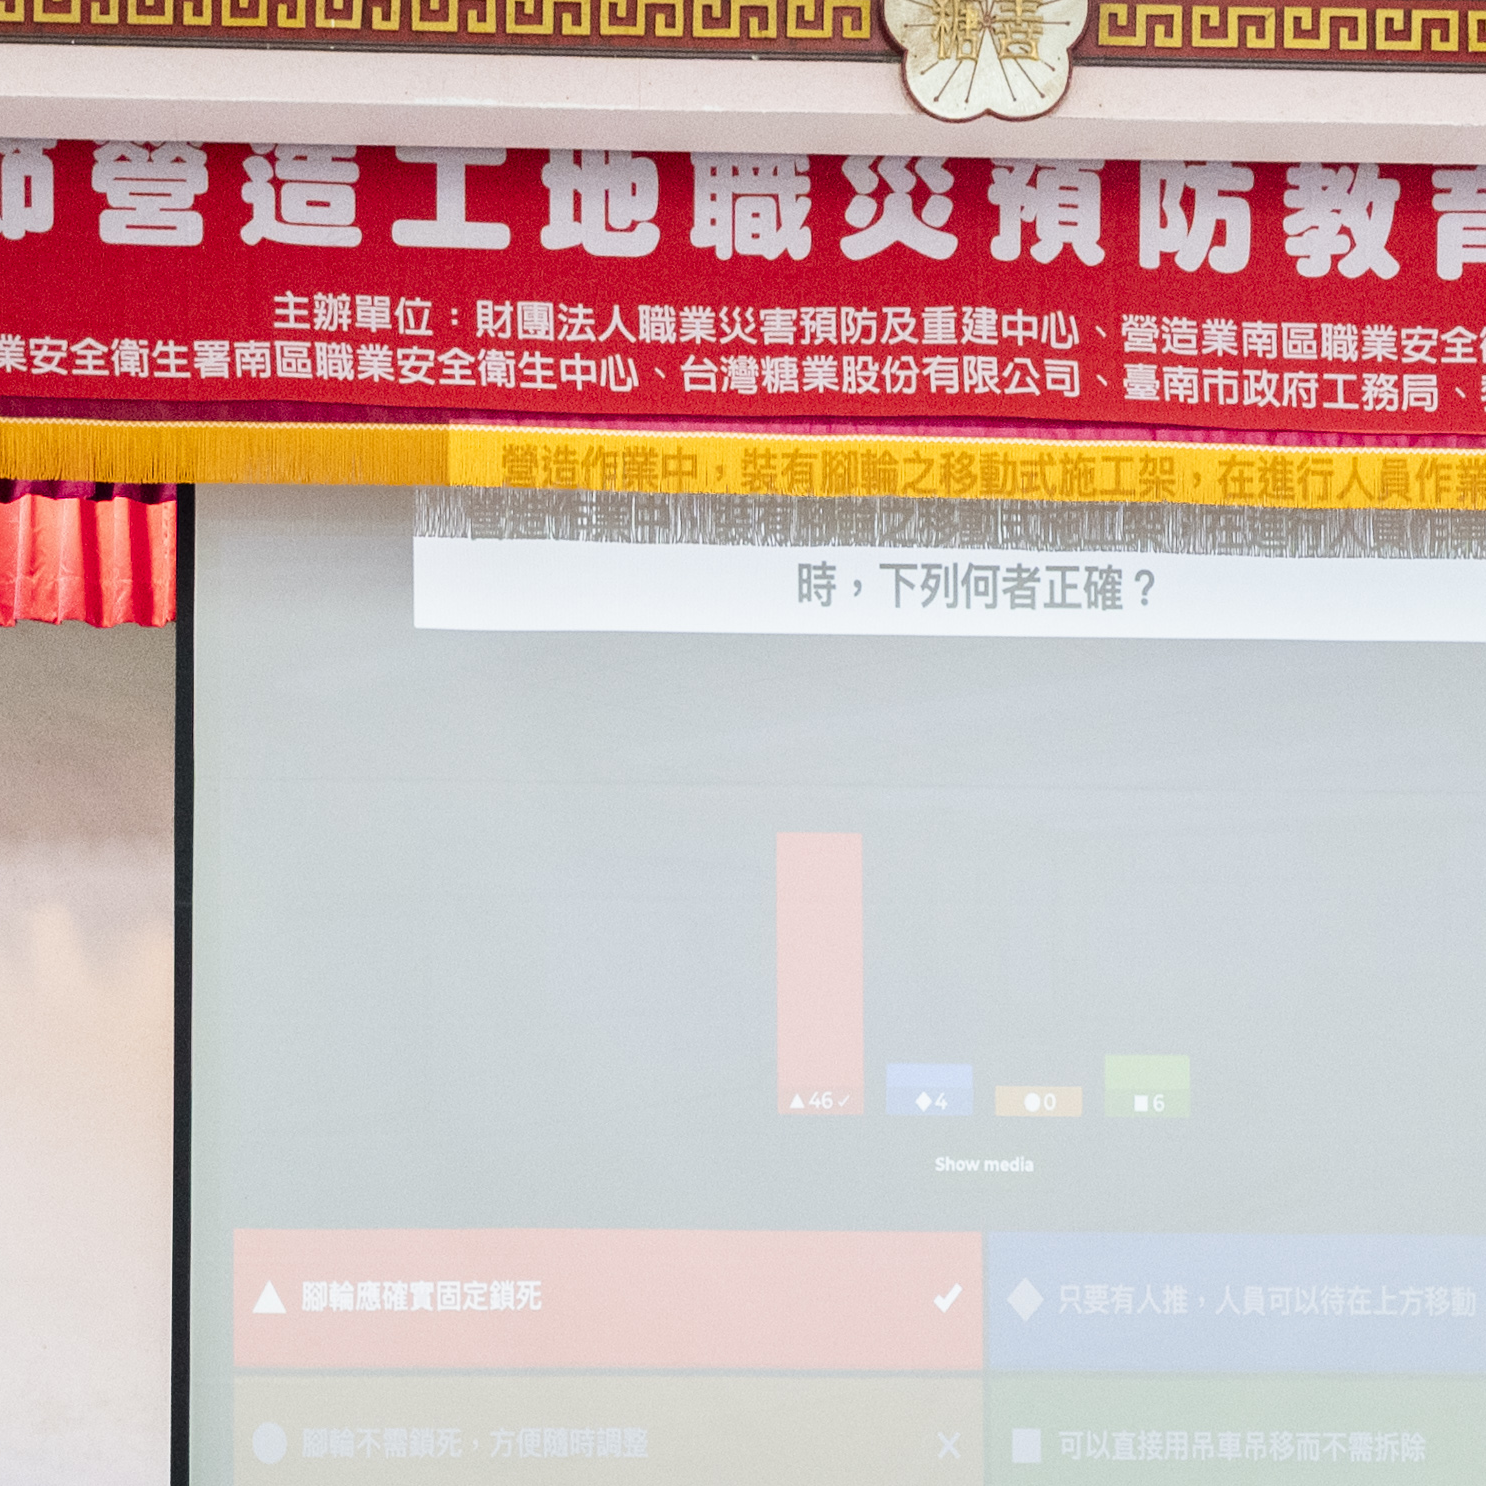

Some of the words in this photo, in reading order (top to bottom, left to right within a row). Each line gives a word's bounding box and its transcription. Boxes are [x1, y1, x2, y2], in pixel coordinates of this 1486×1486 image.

[798, 560, 1155, 612] 時，下列何者正確？
[808, 1091, 833, 1110] 46
[934, 1092, 948, 1110] 4
[1042, 1092, 1057, 1111] 0
[1152, 1093, 1165, 1112] 6
[934, 1156, 980, 1172] Show
[983, 1156, 1035, 1173] media
[301, 1279, 543, 1313] 腳輪應確實固定鎖死
[1059, 1283, 1477, 1318] 只要有人推，人員可以待在上方移動
[301, 1426, 650, 1460] 腳輪不需鎖死，方便隨時調整
[1059, 1429, 1427, 1463] 可以直接用吊車吊移而不需拆除
